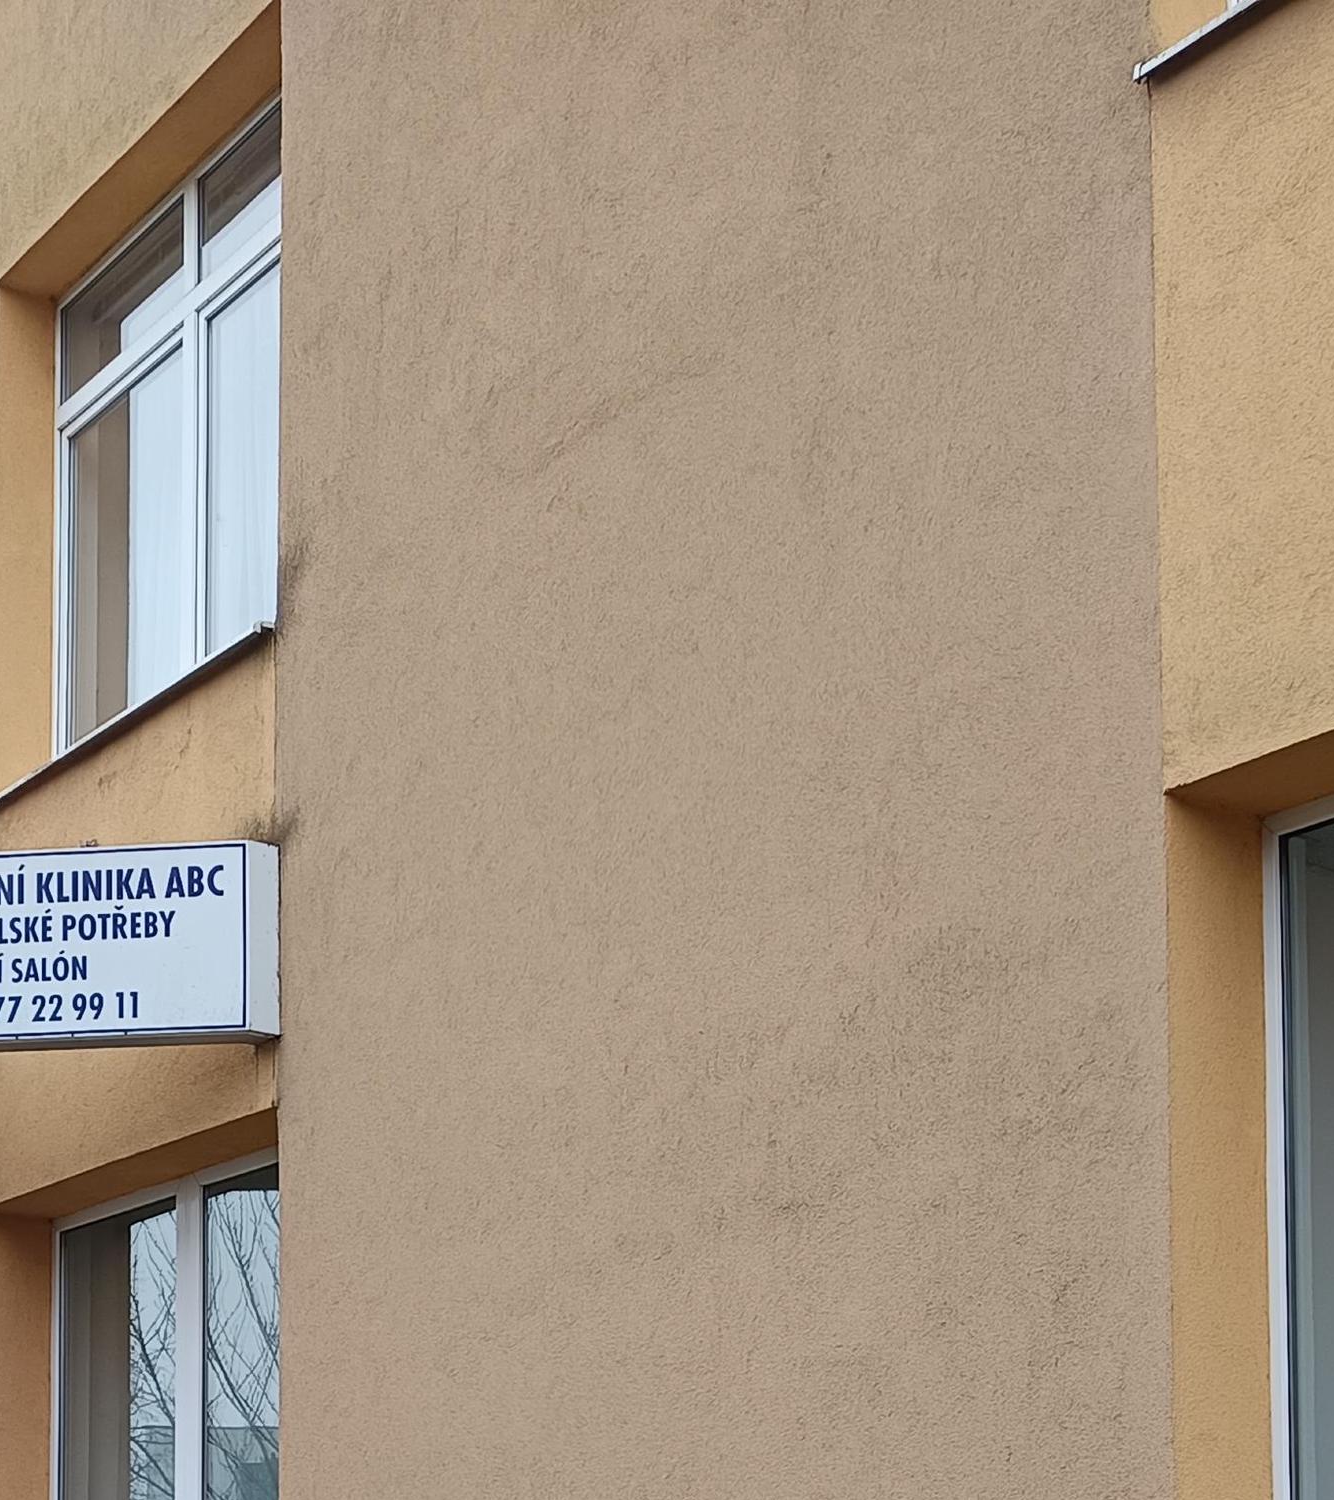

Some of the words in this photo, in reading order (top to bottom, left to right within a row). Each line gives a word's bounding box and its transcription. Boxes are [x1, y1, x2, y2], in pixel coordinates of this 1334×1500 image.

[36, 868, 156, 904] KLINIKA
[164, 865, 225, 899] ABC
[61, 904, 177, 942] POTŘEBY
[10, 949, 88, 983] SALÓN
[31, 994, 63, 1022] 22
[71, 992, 105, 1021] 99
[115, 991, 139, 1019] 11
